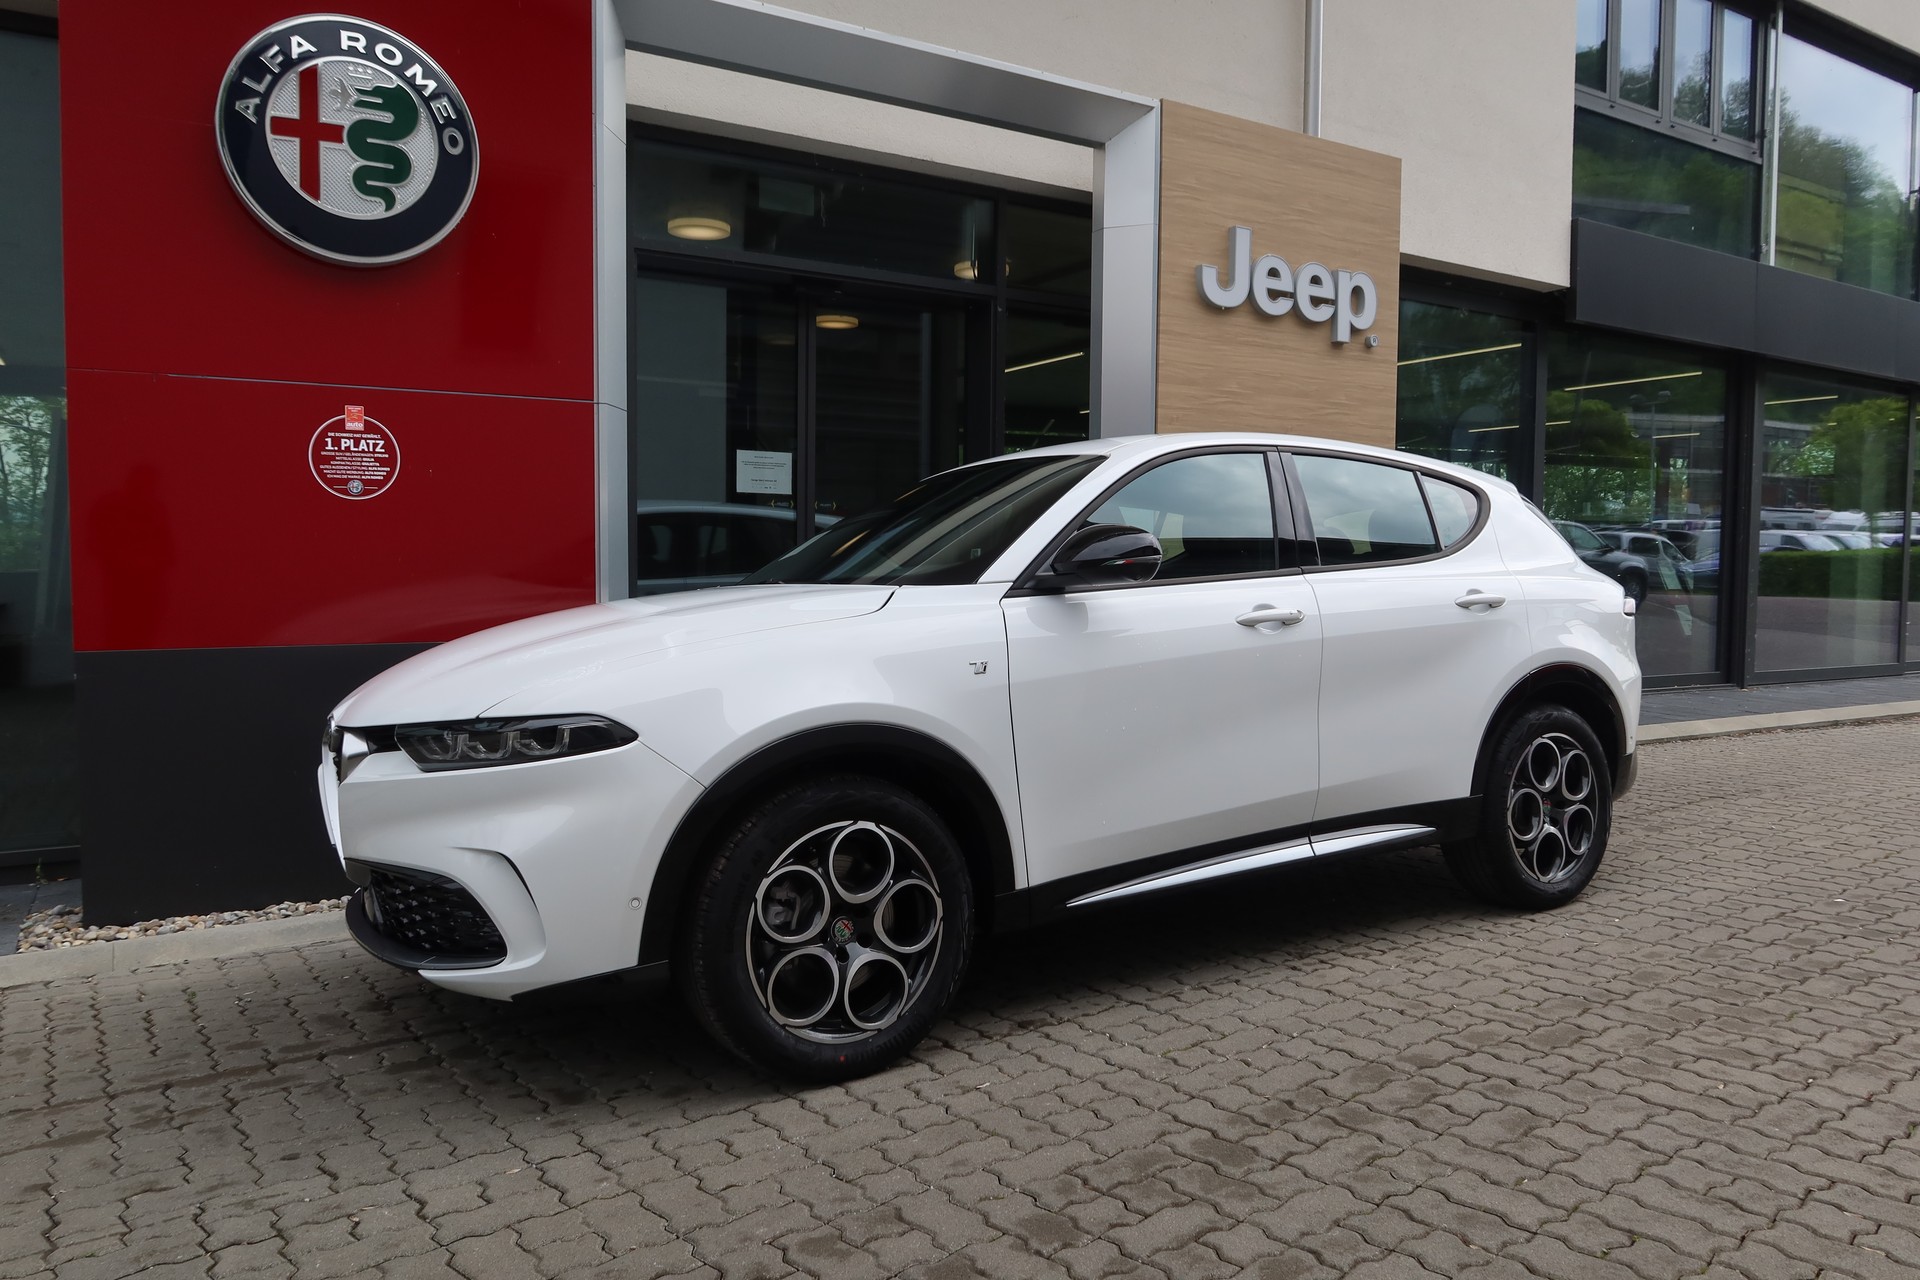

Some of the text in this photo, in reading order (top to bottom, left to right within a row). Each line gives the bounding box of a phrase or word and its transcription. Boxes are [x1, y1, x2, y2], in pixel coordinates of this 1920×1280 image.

[235, 29, 465, 156] ALFA ROMEO
[1196, 224, 1378, 345] Jeep
[325, 437, 385, 452] 1. PLATZ
